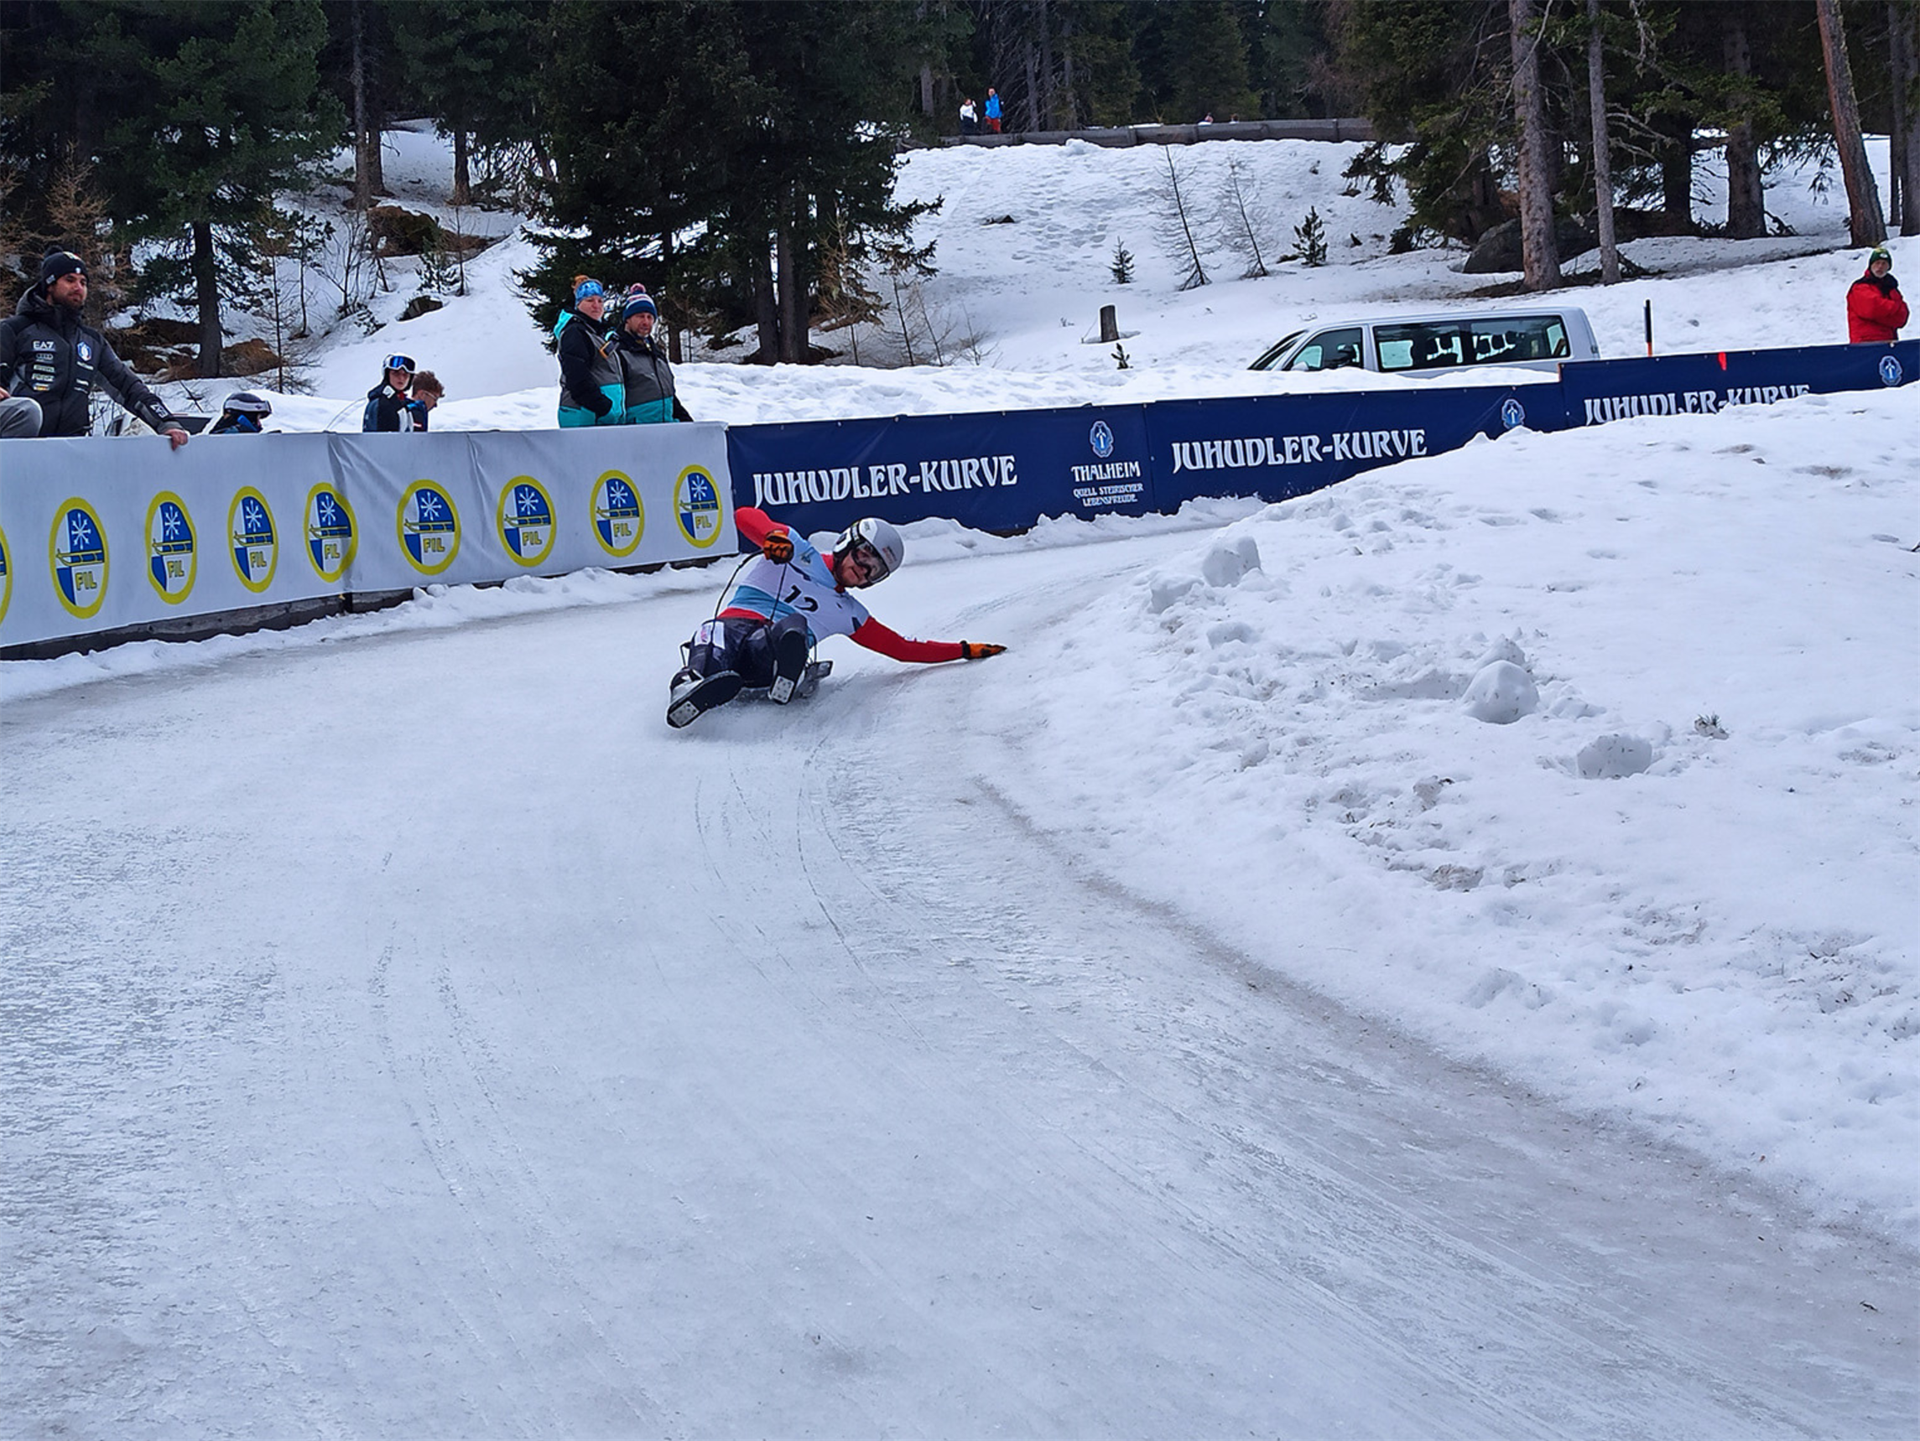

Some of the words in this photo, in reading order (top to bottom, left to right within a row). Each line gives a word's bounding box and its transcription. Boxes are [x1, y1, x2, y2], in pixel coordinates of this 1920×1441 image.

[33, 340, 55, 351] EA7
[1171, 428, 1428, 474] JUHUDLER-KURVE
[1070, 460, 1142, 482] THALHEIM
[752, 455, 1018, 509] JUHUDLER-KURVE
[1073, 487, 1098, 499] QUELL
[613, 522, 632, 538] FIL
[695, 515, 712, 529] FIL
[423, 536, 445, 553] FIL
[521, 530, 543, 547] FIL
[250, 550, 267, 568] FIL
[324, 543, 340, 560] FIL
[167, 560, 185, 578] FIL
[75, 571, 98, 591] FIL
